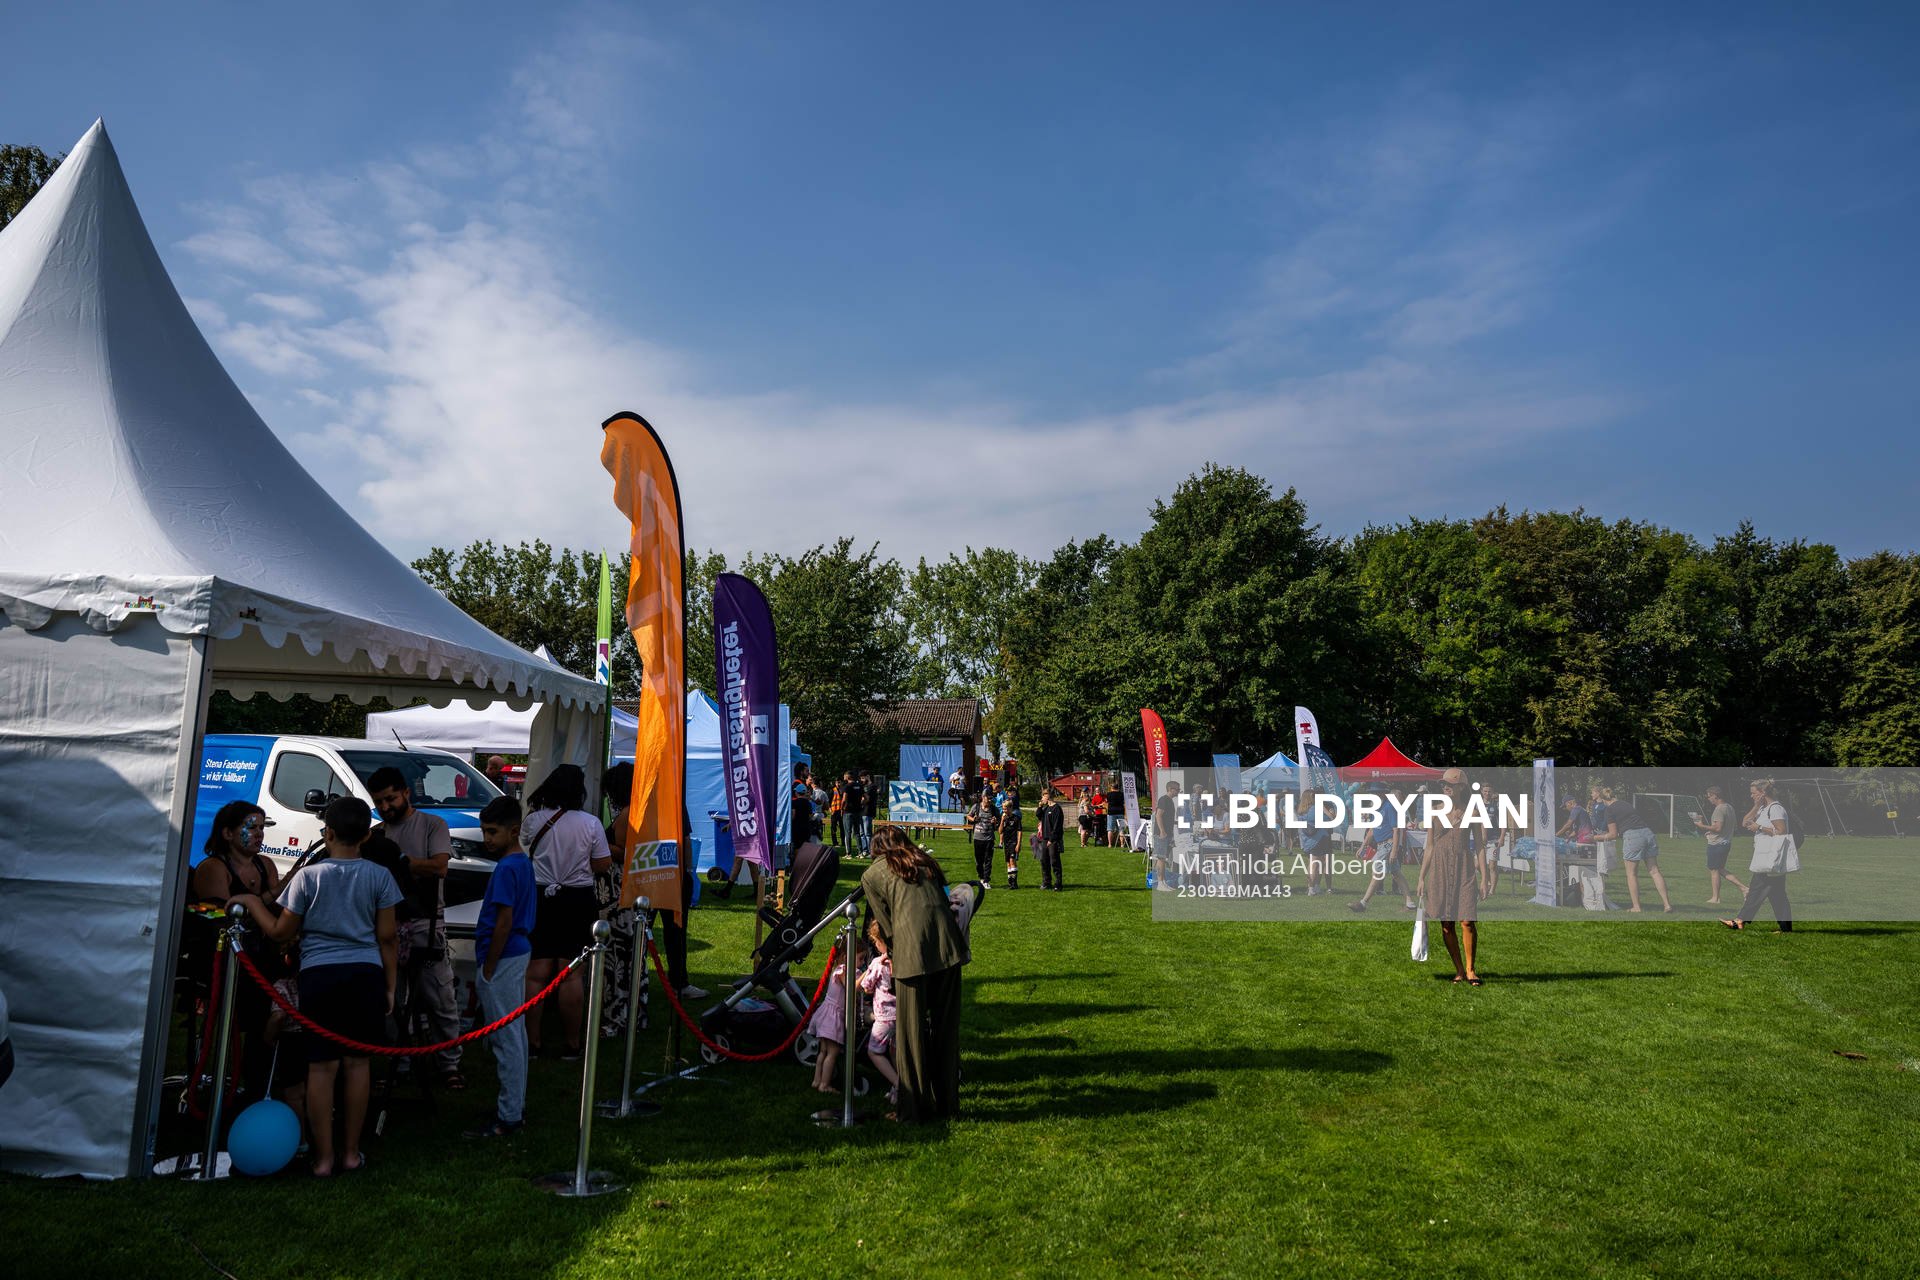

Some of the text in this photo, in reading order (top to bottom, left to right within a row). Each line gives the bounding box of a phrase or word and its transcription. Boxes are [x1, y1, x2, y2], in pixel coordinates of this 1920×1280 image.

[205, 758, 258, 771] Stena Fastigheter
[206, 772, 212, 781] vi
[212, 771, 222, 782] kör
[222, 771, 247, 783] hållbart
[259, 843, 281, 855] Stena
